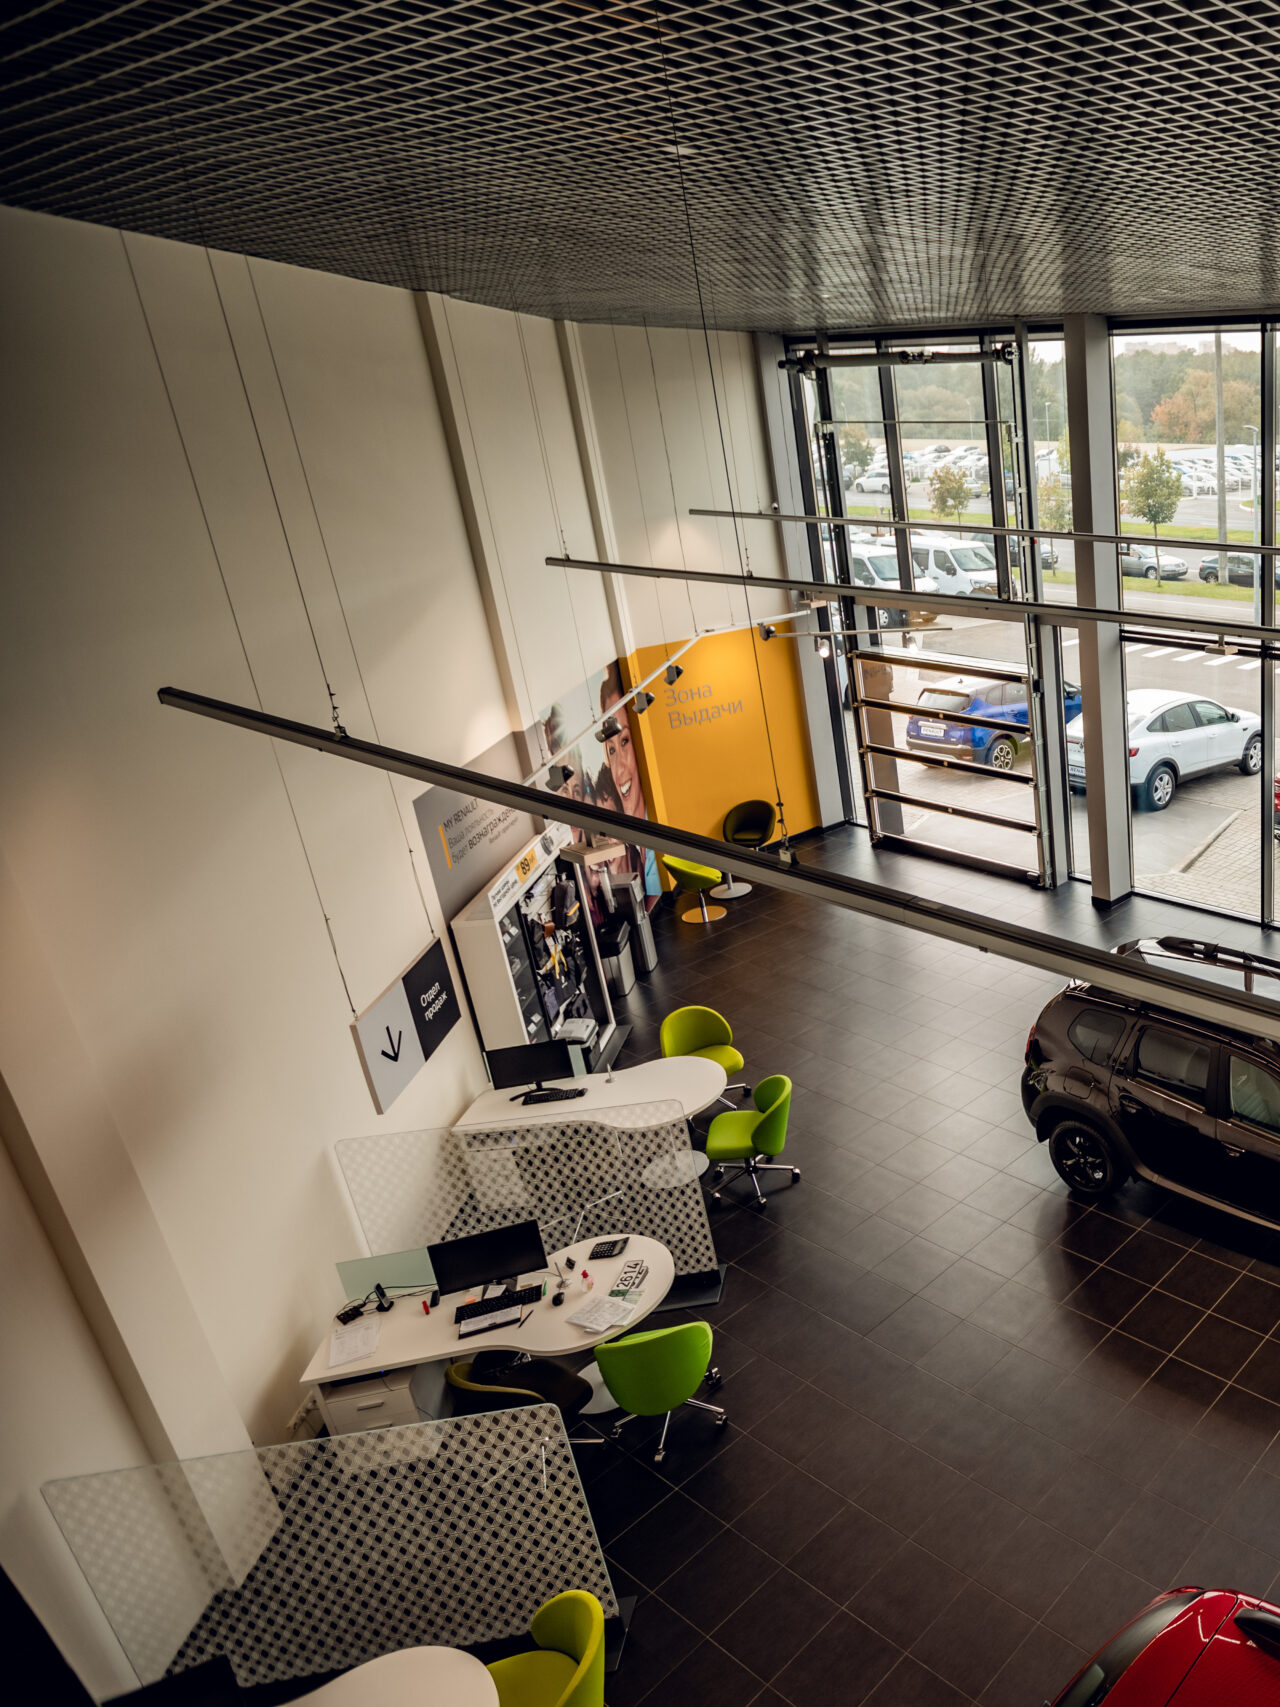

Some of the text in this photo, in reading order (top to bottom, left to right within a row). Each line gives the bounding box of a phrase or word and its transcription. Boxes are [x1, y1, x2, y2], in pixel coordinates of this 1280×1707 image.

[664, 684, 712, 706] Зона
[669, 700, 743, 729] Выдачи
[443, 798, 478, 832] MY RENAULT
[420, 982, 440, 1007] Отдел
[425, 991, 448, 1021] продаж
[616, 1263, 640, 1288] 2614
